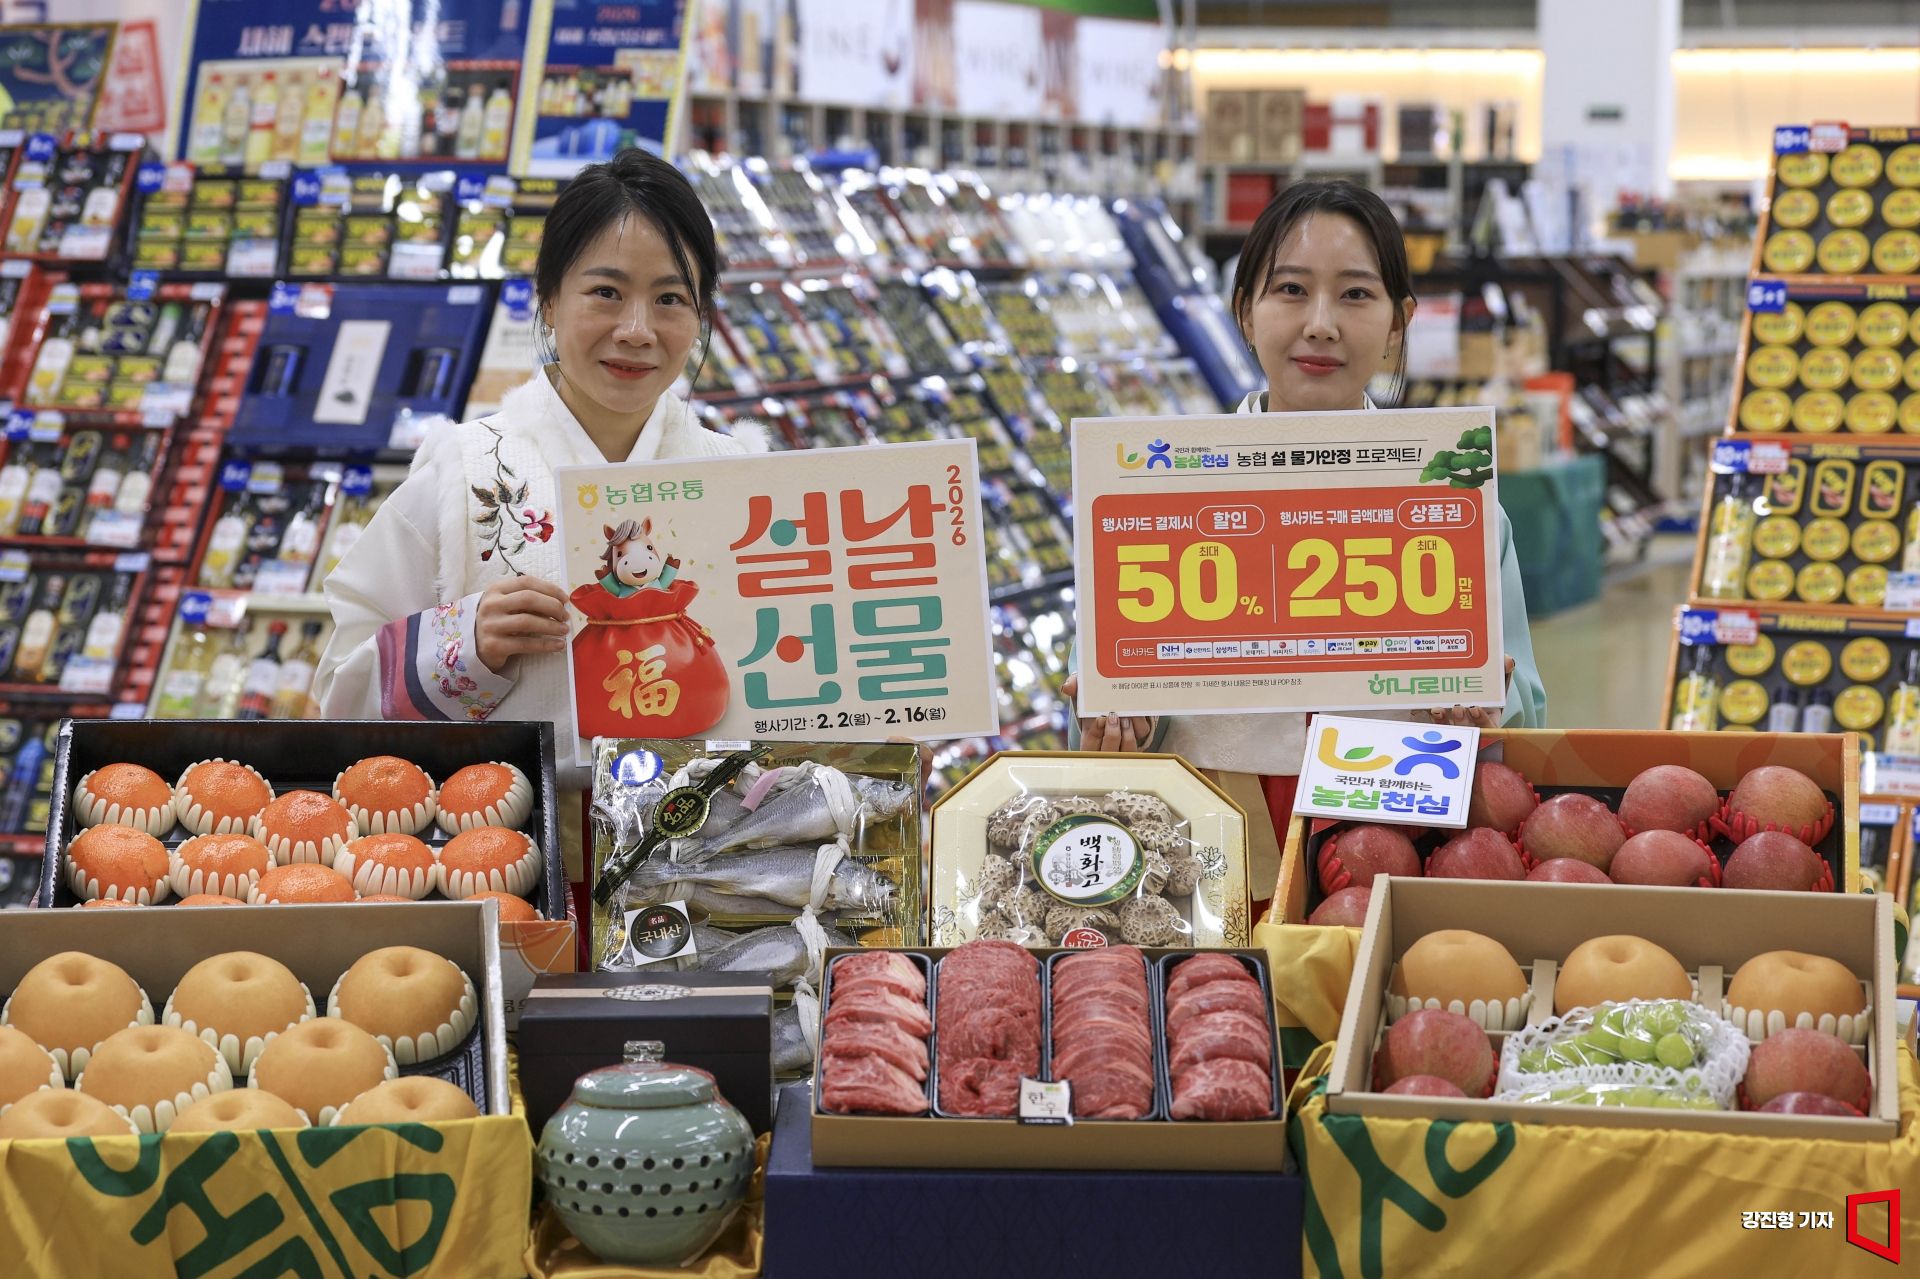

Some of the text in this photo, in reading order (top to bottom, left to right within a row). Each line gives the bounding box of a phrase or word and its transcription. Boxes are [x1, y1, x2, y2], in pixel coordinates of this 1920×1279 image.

[1750, 285, 1786, 306] 5+1
[1174, 454, 1229, 469] 농심천심
[1237, 447, 1422, 468] 농협 설 물가안정 프로젝트!
[606, 479, 705, 506] 농협유통
[946, 464, 967, 546] 2026
[1409, 503, 1463, 524] 상품권
[1102, 515, 1193, 532] 행사카드 결제시
[1212, 510, 1248, 531] 할인
[1279, 508, 1395, 527] 행사카드 구매 금액대별
[729, 484, 947, 598] 설날
[1199, 545, 1219, 557] 최대
[1417, 539, 1438, 551] 최대
[1287, 535, 1456, 618] 250
[736, 595, 951, 710] 선물
[1122, 647, 1155, 657] 행사카드
[1161, 645, 1180, 653] NH
[1216, 646, 1238, 654] 삼성카드
[602, 643, 681, 719] 福
[1367, 673, 1484, 696] 하나로마트
[754, 717, 808, 734] 행사기간
[1334, 775, 1433, 792] 국민과 함께하는
[1311, 785, 1451, 816] 농심천심
[1080, 834, 1104, 888] 백화고
[639, 923, 682, 945] 국내산
